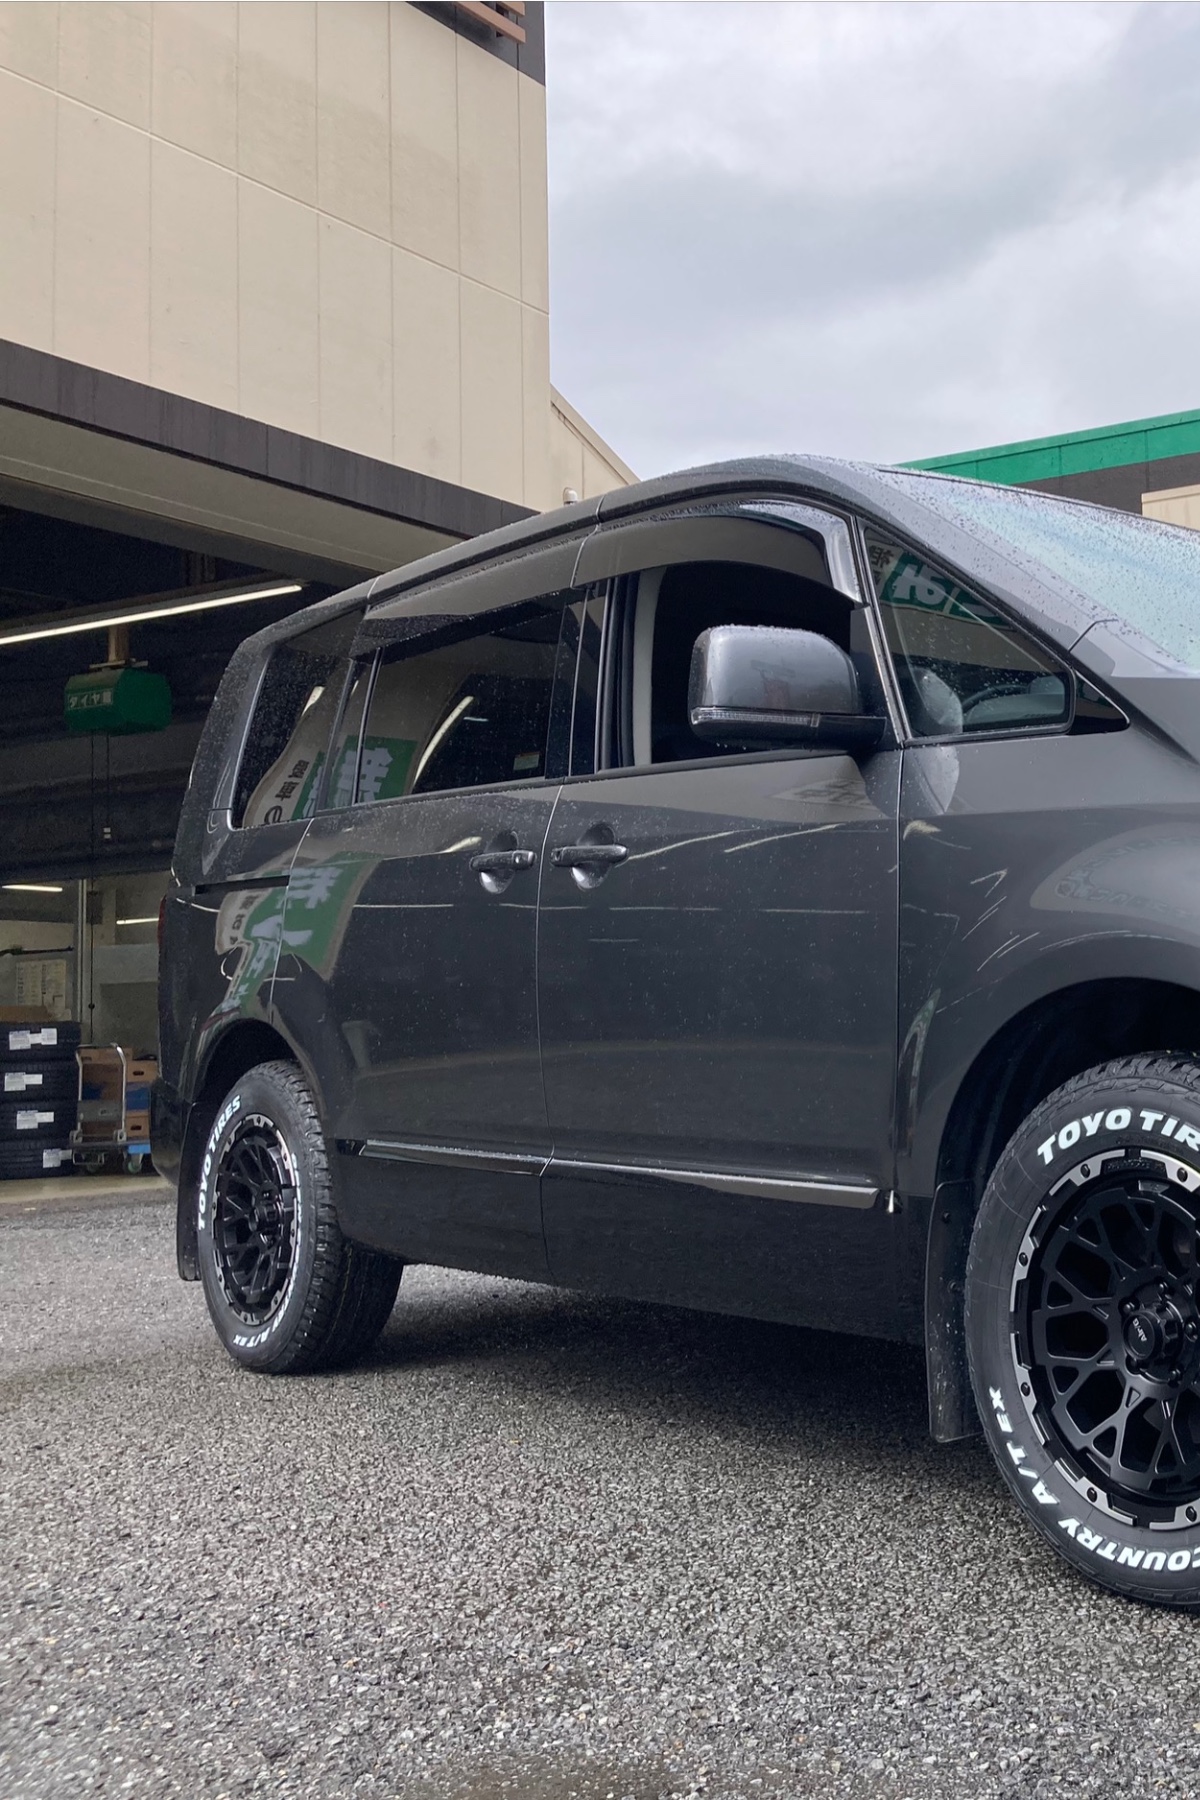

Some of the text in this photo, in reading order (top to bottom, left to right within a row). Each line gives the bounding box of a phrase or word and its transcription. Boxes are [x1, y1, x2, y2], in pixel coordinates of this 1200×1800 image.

[198, 1094, 241, 1231] TOYO TIRES
[1037, 1108, 1133, 1166] TOYO
[989, 1386, 1014, 1433] EX
[1006, 1441, 1060, 1505] A/T
